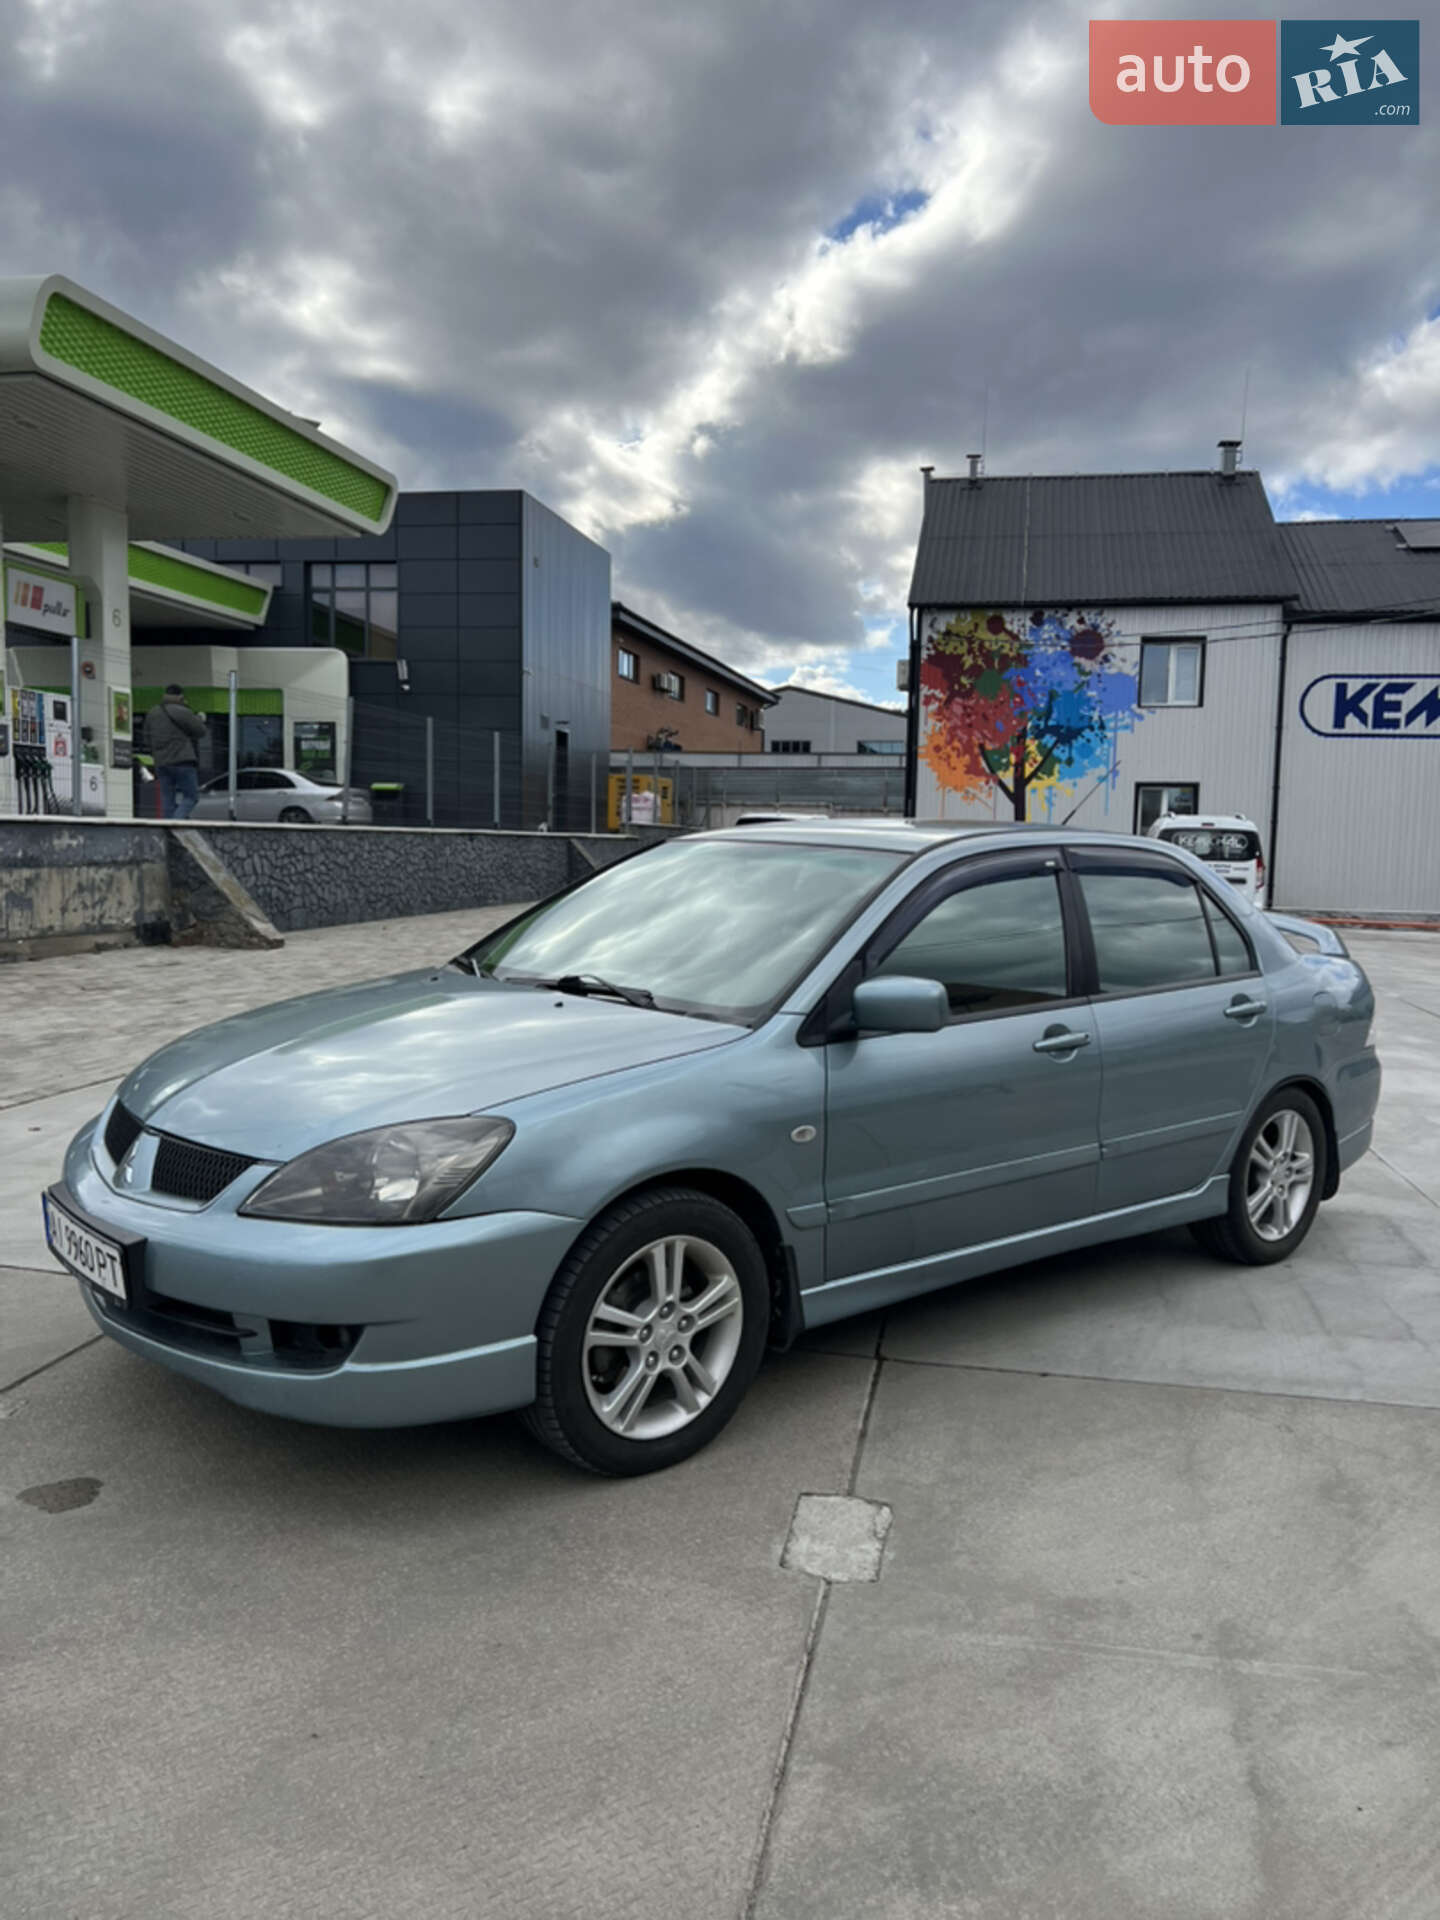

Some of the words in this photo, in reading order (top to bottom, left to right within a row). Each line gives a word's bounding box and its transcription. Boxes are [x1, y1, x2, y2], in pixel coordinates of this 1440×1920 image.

[111, 608, 122, 628] 6
[89, 776, 98, 792] 6
[95, 1246, 118, 1289] PT
